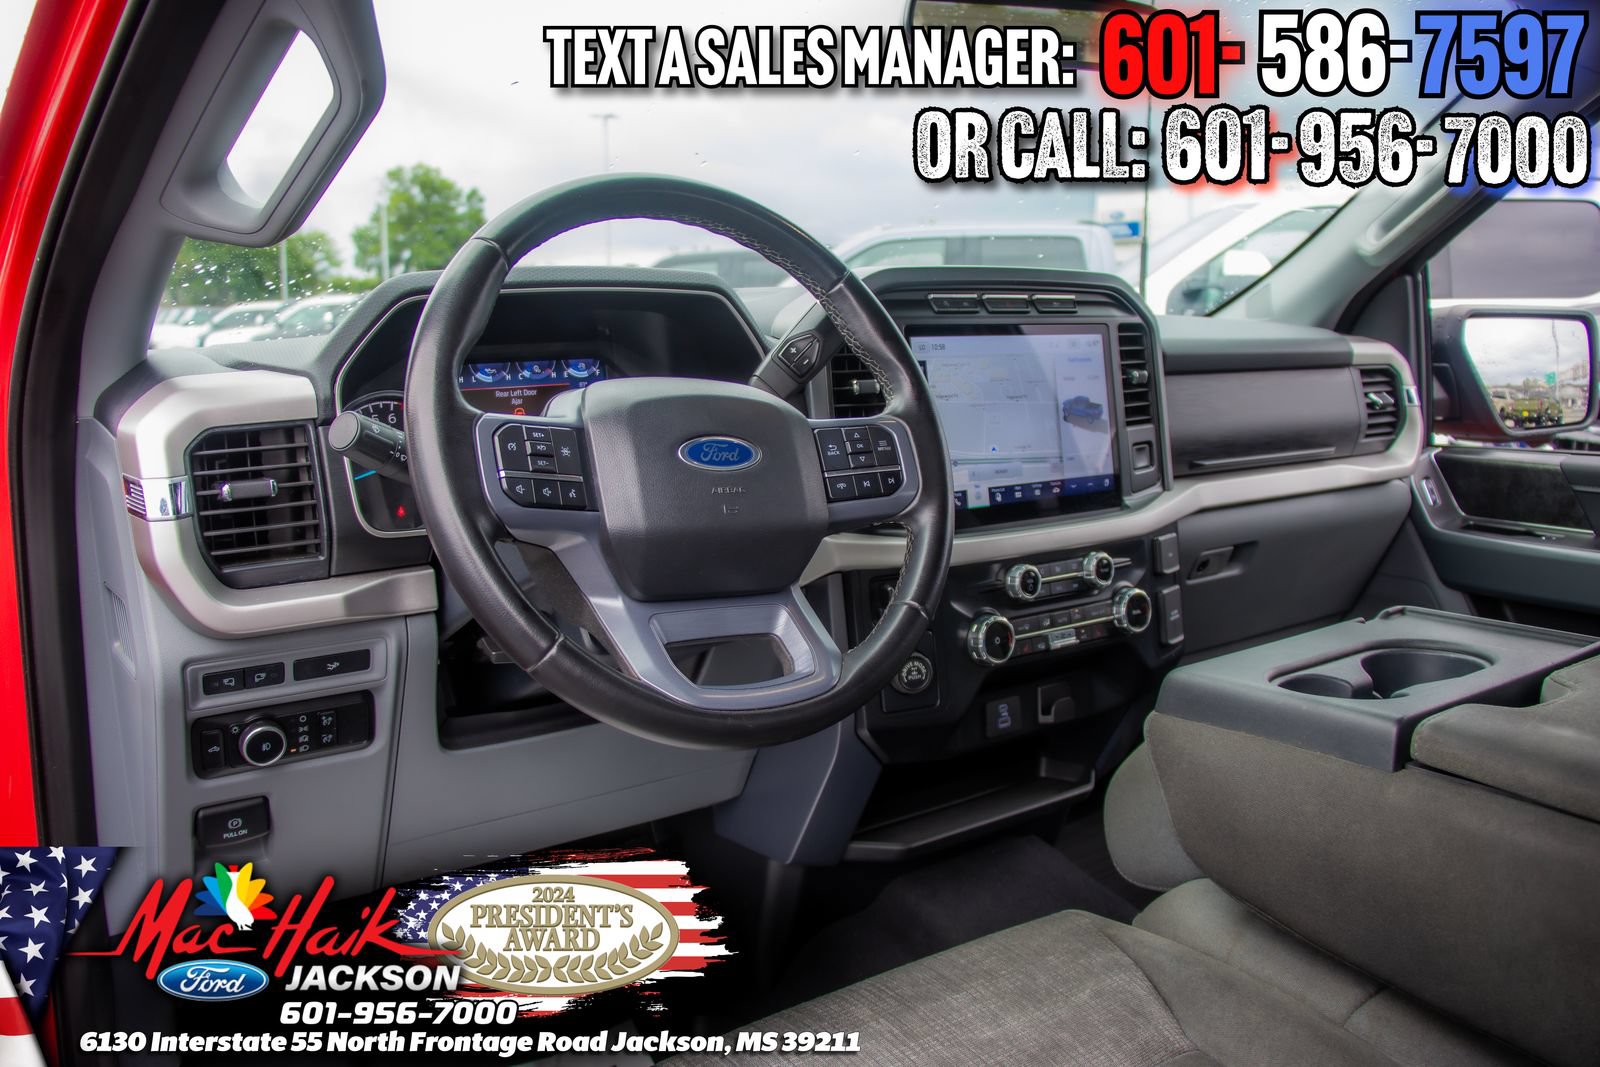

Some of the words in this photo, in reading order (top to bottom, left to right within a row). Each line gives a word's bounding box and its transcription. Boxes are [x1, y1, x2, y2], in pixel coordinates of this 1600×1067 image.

[523, 389, 537, 397] Door
[388, 413, 397, 424] 6
[700, 443, 741, 463] Ford
[223, 831, 239, 839] PULL
